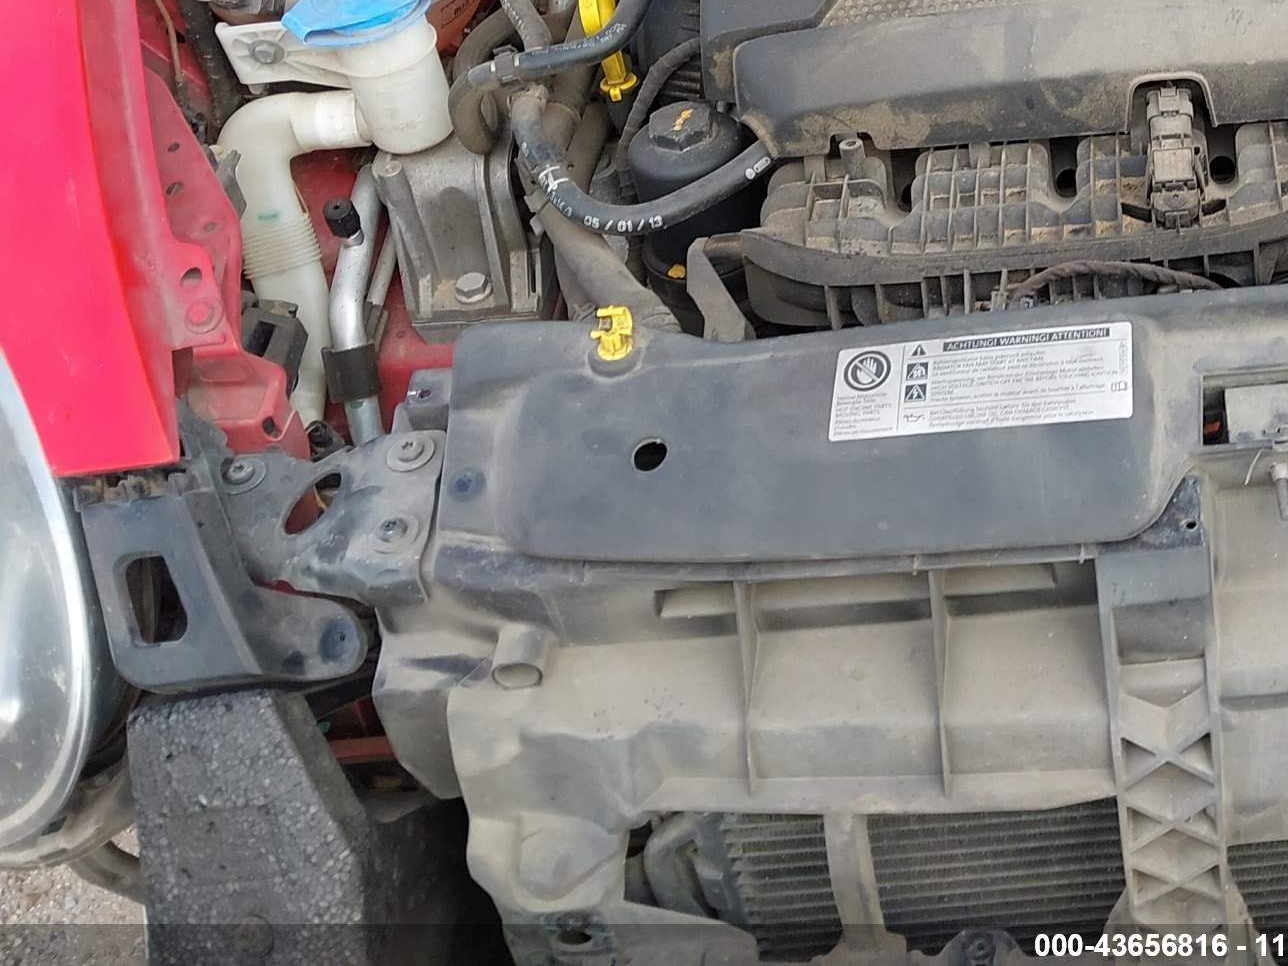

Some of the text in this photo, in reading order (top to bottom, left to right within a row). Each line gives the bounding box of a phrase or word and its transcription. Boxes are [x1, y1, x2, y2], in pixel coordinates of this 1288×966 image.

[946, 329, 1107, 351] ACHTUNG! WARNING! ATTENTION!
